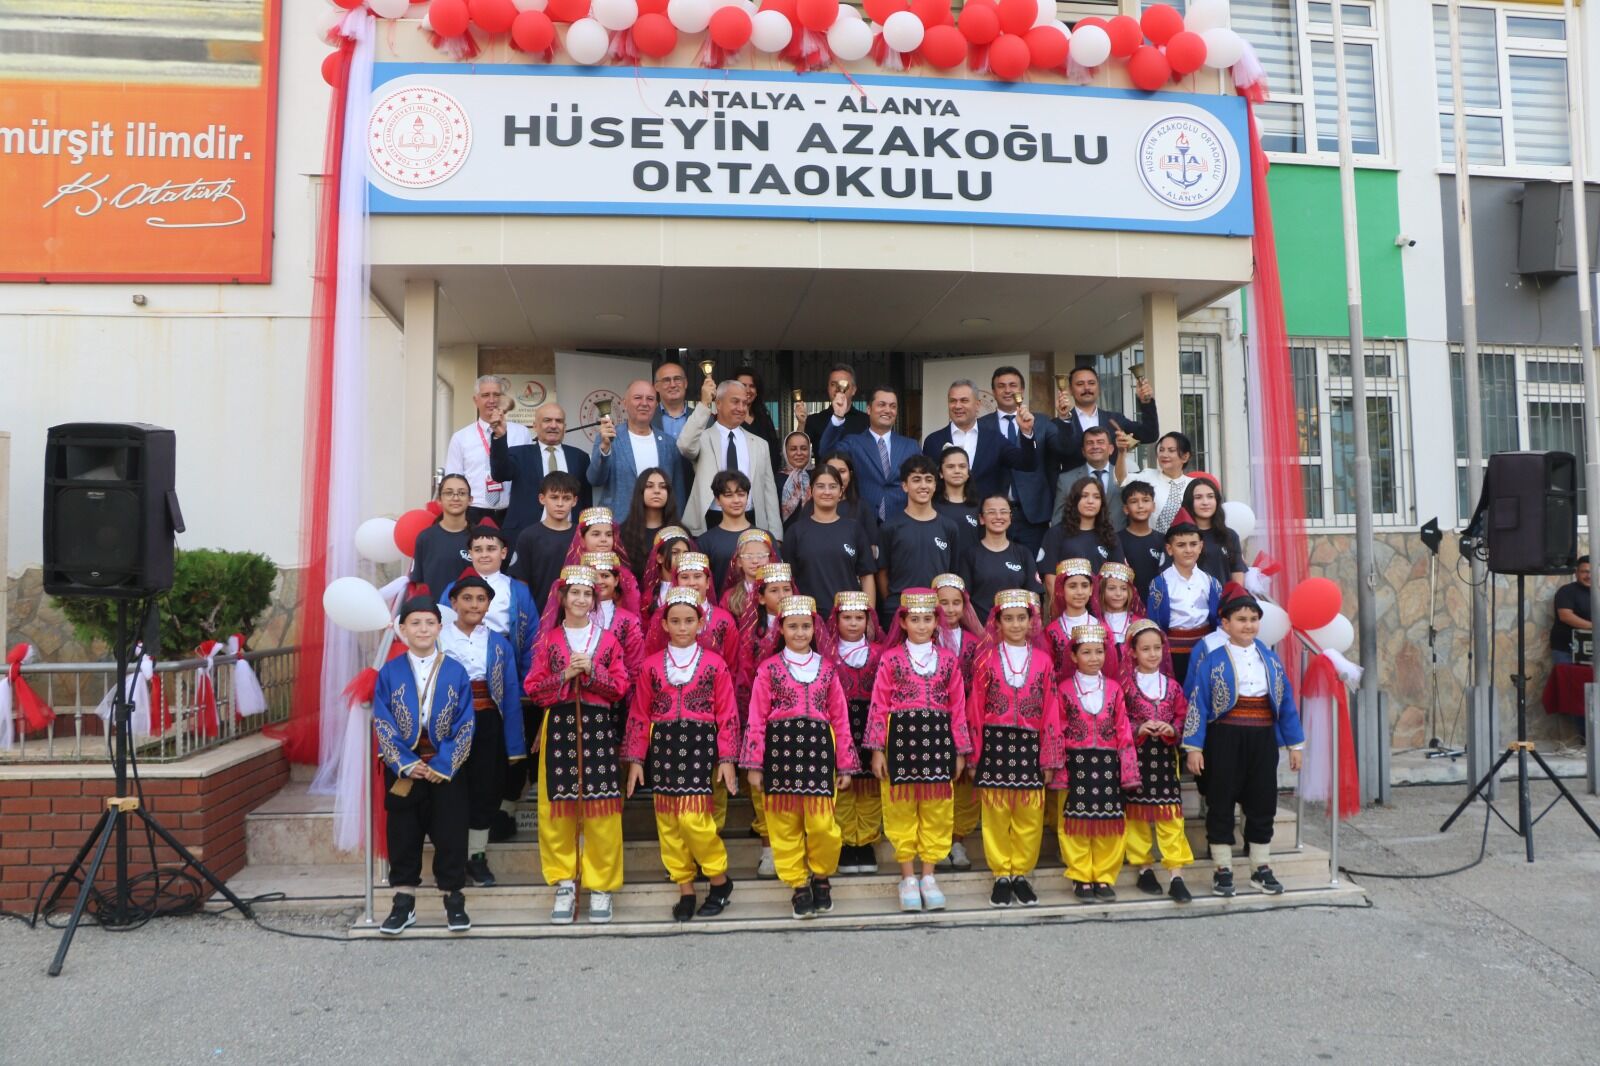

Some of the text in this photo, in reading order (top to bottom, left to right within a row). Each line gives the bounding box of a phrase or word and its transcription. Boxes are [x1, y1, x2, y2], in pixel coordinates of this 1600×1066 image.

[665, 91, 804, 110] ANTALYA
[838, 96, 960, 116] ALANYA
[0, 119, 251, 164] mürşit ilimdir.
[505, 103, 1107, 165] HÜSEYİN AZAKOĞLU
[1201, 132, 1222, 181] ORTAOKULU
[633, 161, 991, 201] ORTAOKULU
[1166, 191, 1204, 202] ALANYA
